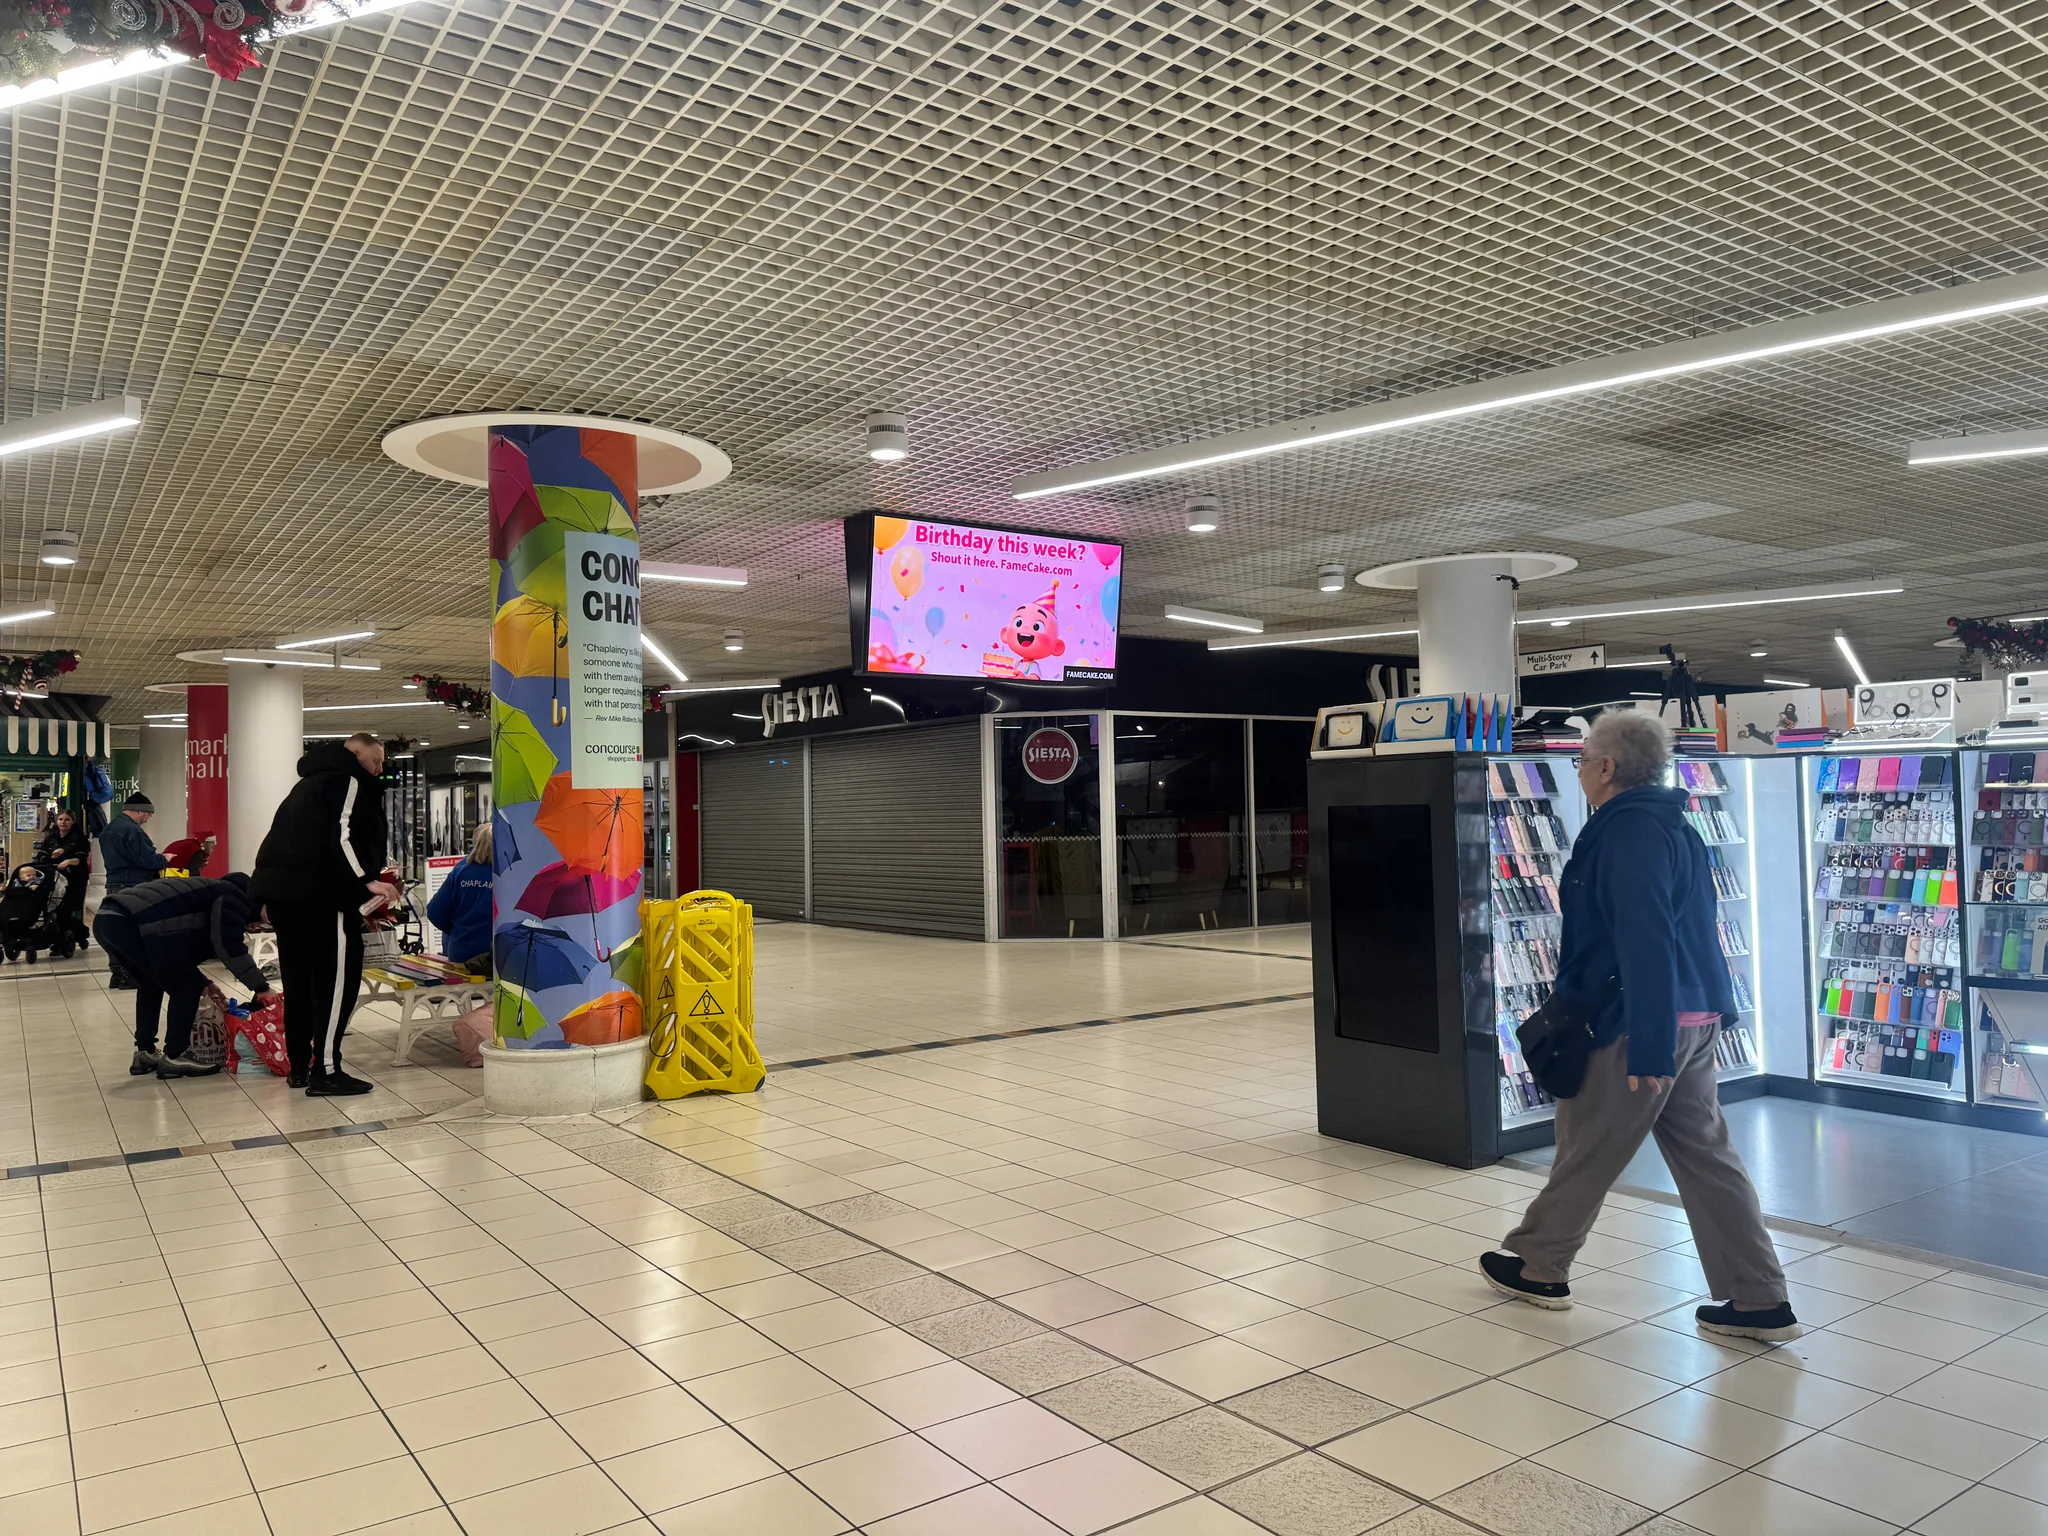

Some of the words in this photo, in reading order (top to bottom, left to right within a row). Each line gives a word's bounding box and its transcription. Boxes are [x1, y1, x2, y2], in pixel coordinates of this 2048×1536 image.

[915, 525, 994, 554] Birthday
[998, 535, 1029, 554] this
[1033, 543, 1086, 561] week?
[931, 552, 962, 565] Shout
[964, 554, 971, 566] it
[973, 556, 999, 568] here.
[1000, 560, 1073, 576] FameCake.com
[583, 643, 628, 656] "Chaplaincy
[1527, 653, 1573, 664] Multi-Storey
[583, 659, 621, 667] someone
[622, 660, 633, 669] who
[1549, 661, 1567, 670] Park
[583, 671, 603, 680] with
[604, 672, 623, 681] them
[1066, 671, 1114, 680] FAMECAKE.COM
[584, 685, 611, 695] longer
[584, 699, 603, 708] with
[604, 700, 620, 708] that
[761, 684, 844, 738] SIESTA
[585, 744, 636, 754] concourse
[1028, 747, 1071, 762] SIESTA
[186, 756, 229, 779] hall
